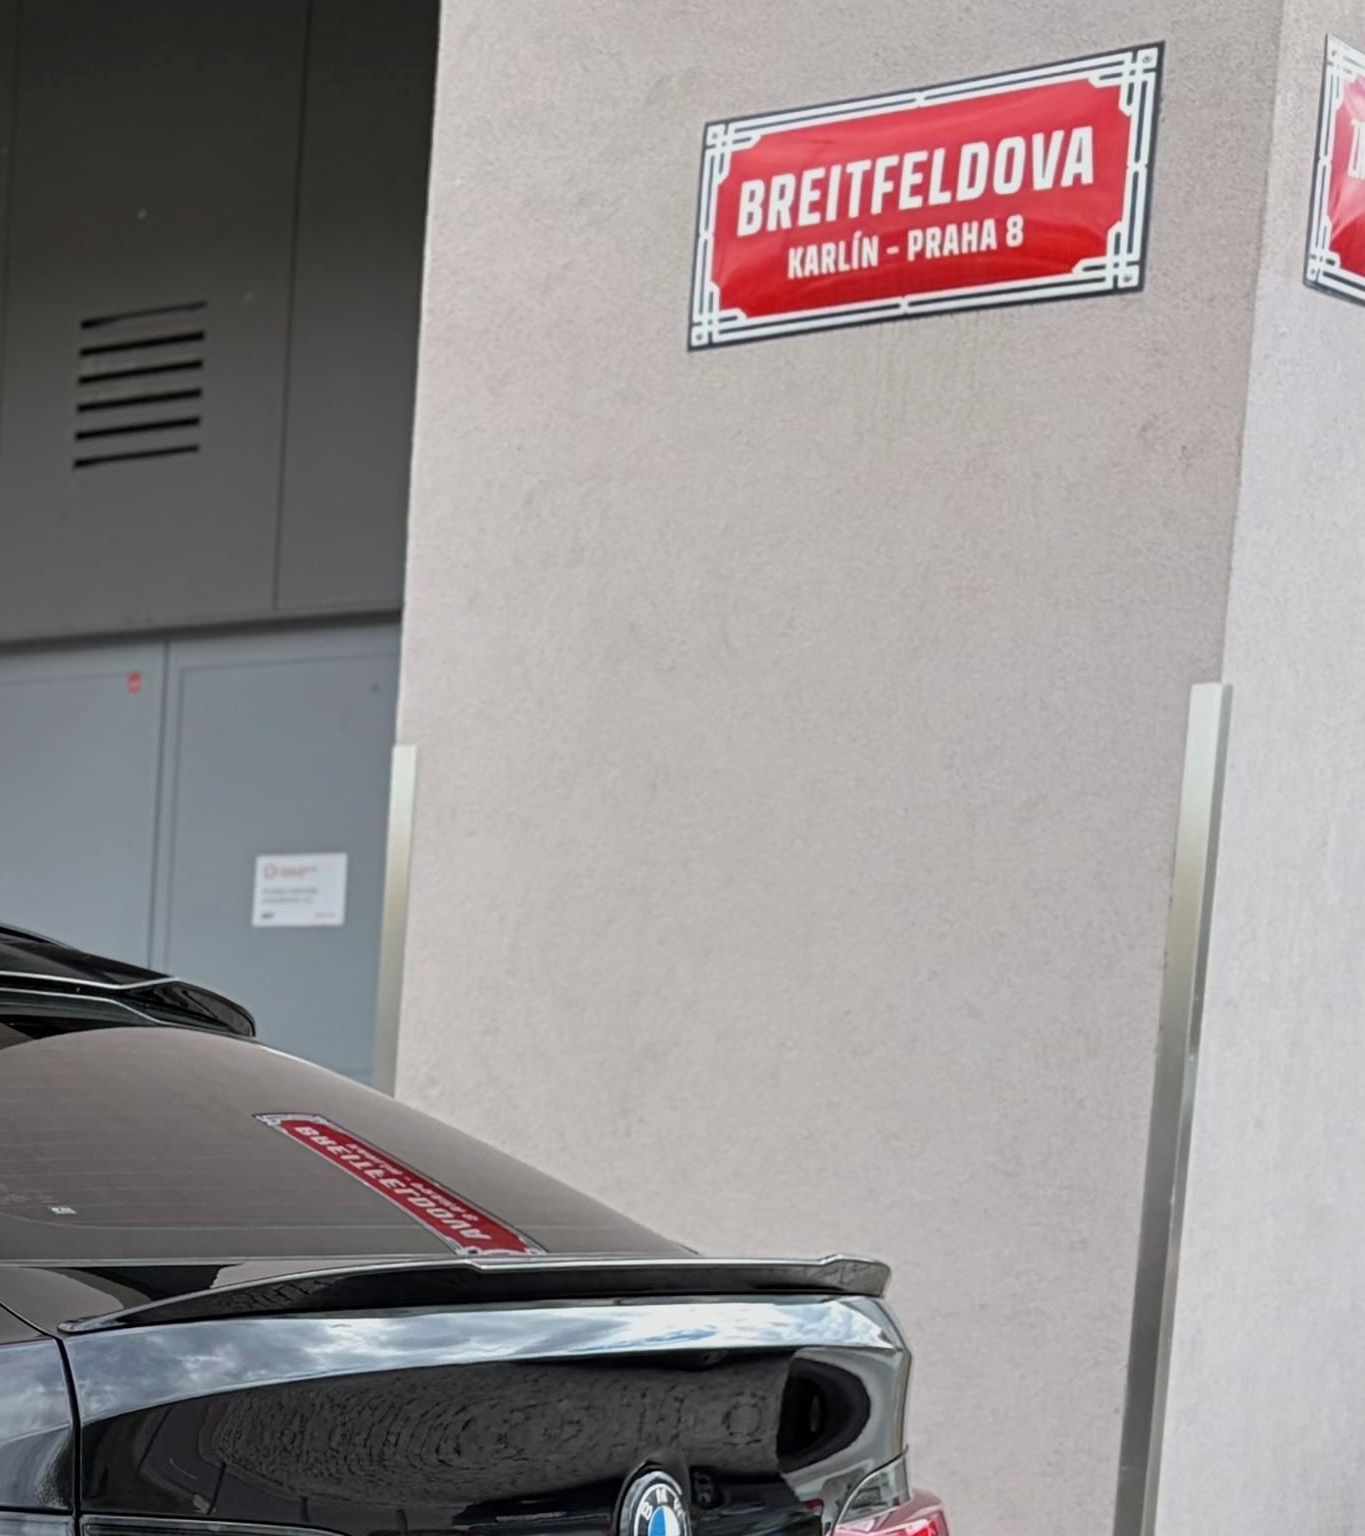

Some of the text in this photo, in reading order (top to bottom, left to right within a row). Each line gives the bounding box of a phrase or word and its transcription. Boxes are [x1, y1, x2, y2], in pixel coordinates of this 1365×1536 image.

[737, 126, 1094, 237] BREITFELDOVA
[787, 230, 879, 279] KARLÍN
[907, 218, 997, 261] PRAHA
[1005, 215, 1024, 247] 8
[640, 1487, 687, 1521] BMW
